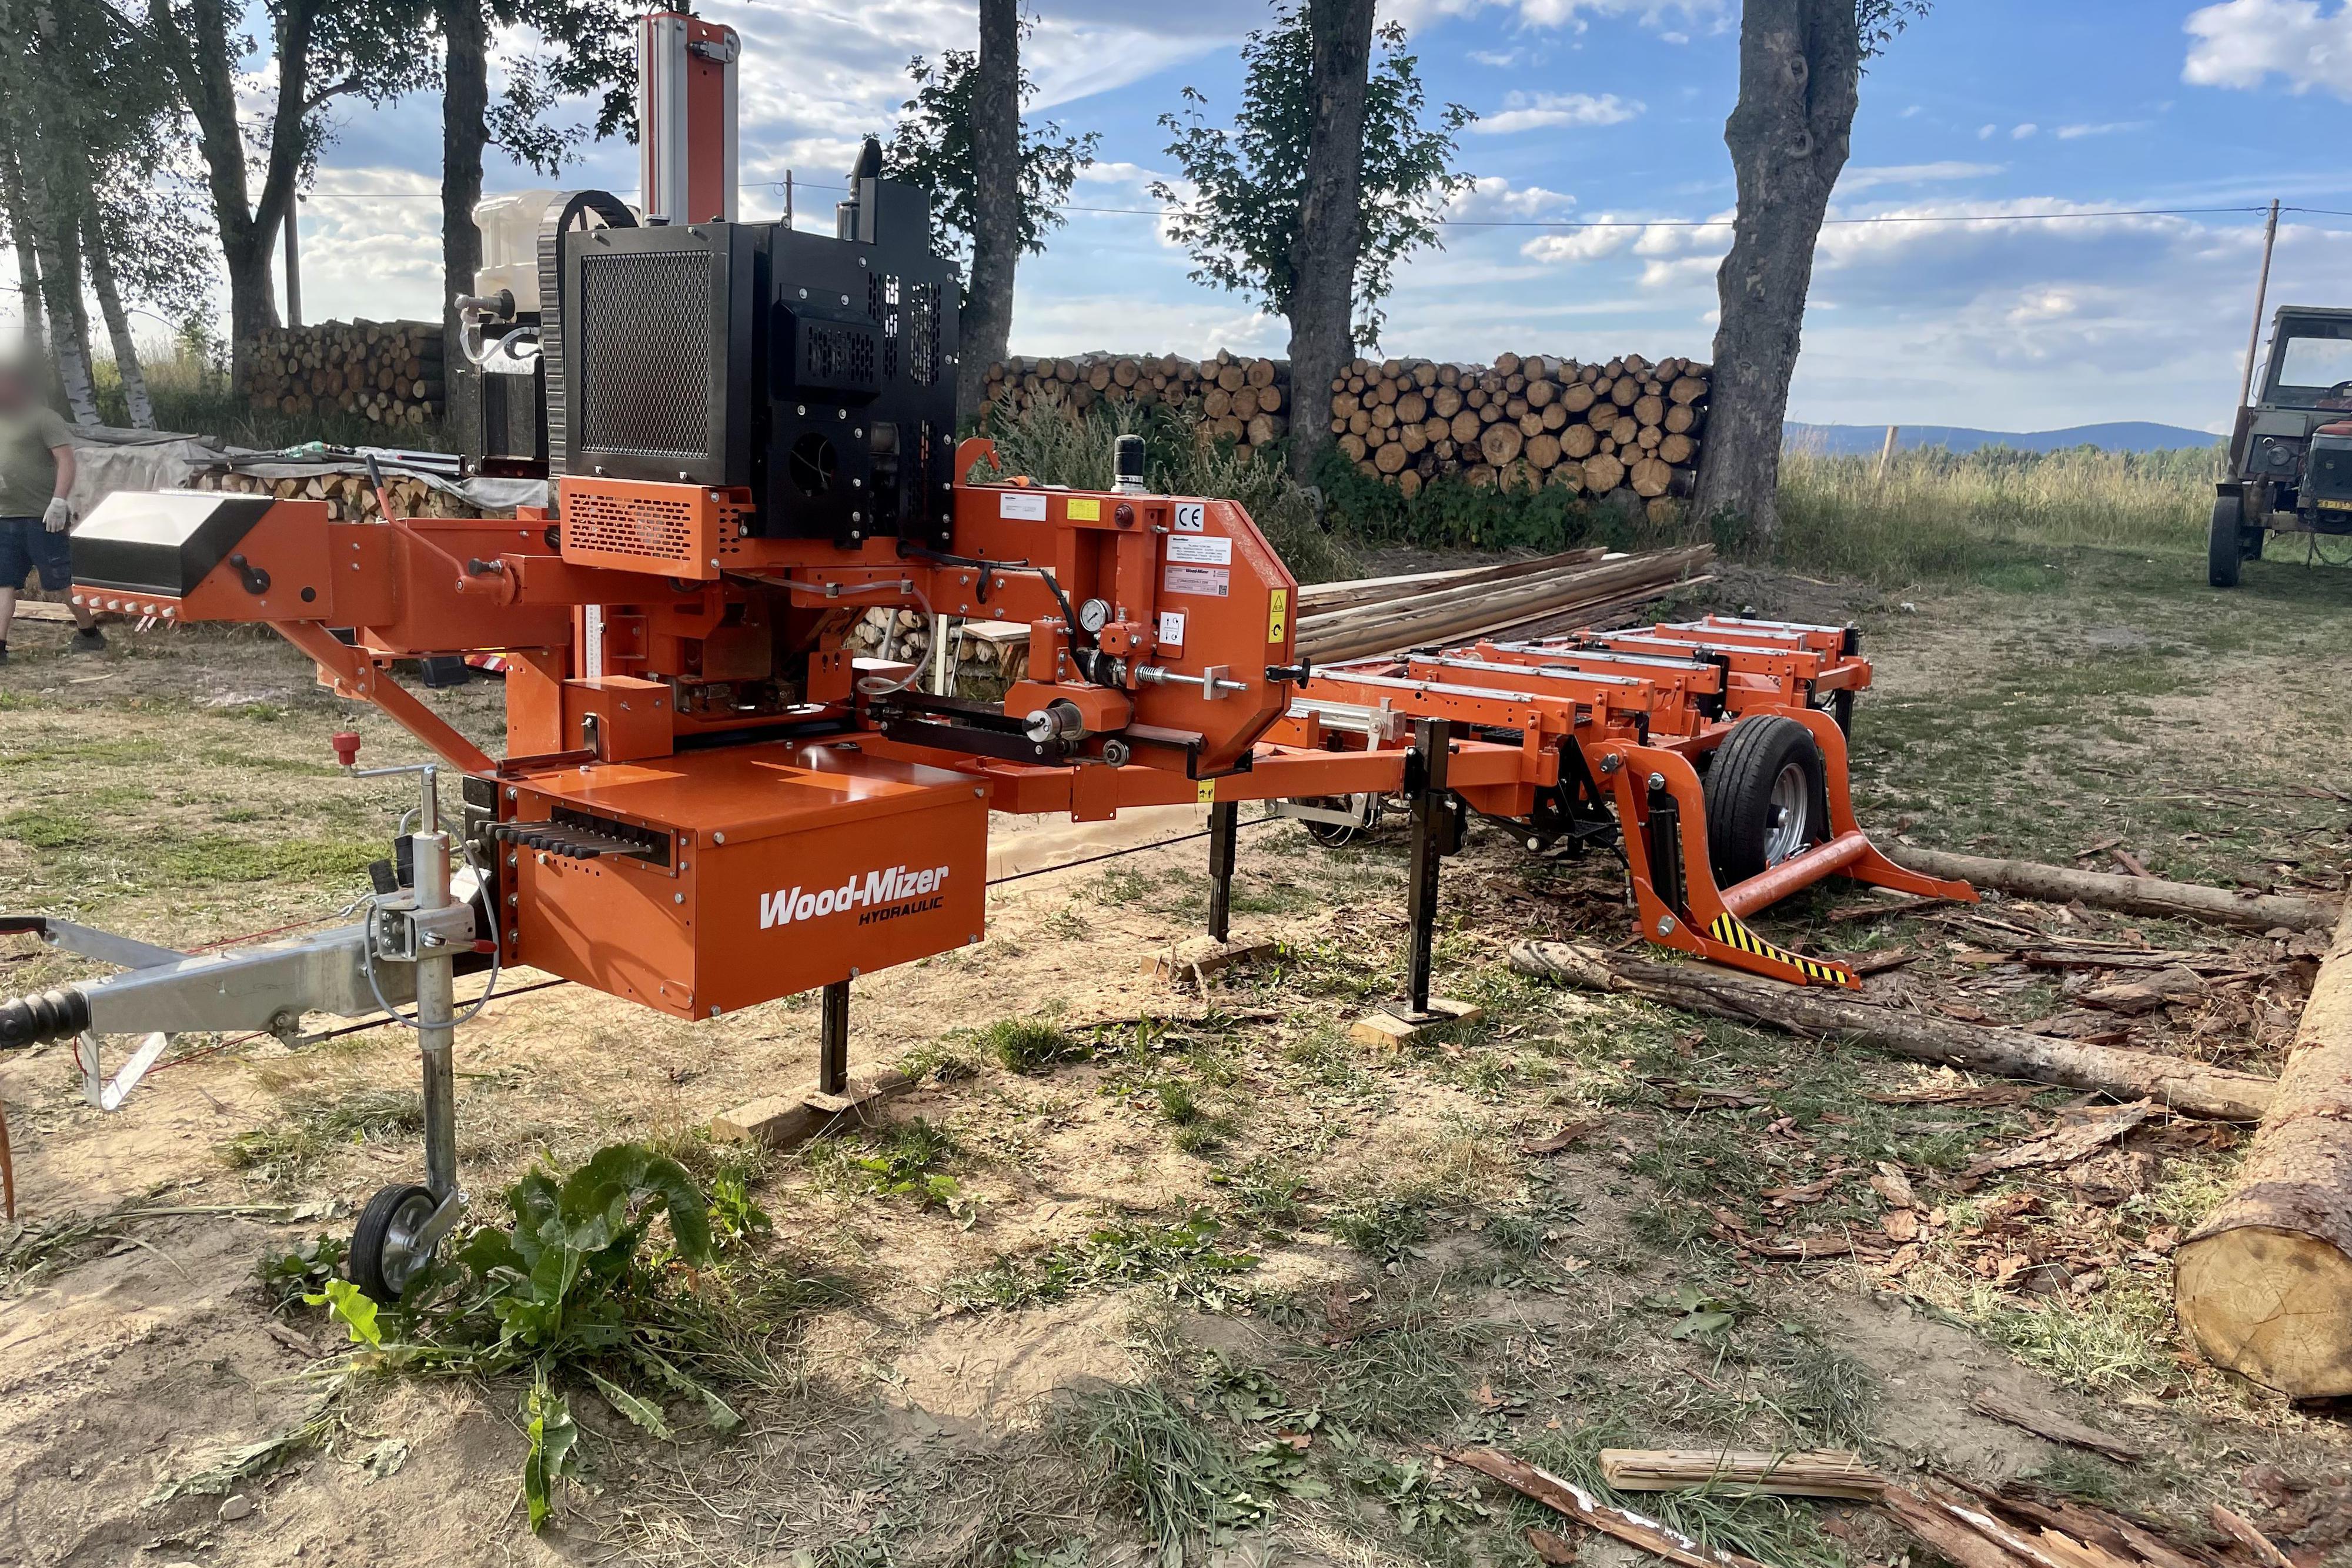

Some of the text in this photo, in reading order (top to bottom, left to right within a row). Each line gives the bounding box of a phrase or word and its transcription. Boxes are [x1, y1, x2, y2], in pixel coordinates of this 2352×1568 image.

[1179, 507, 1201, 527] CE
[760, 865, 949, 930] Wood-Mizer
[858, 896, 944, 926] HYDRAULIC
